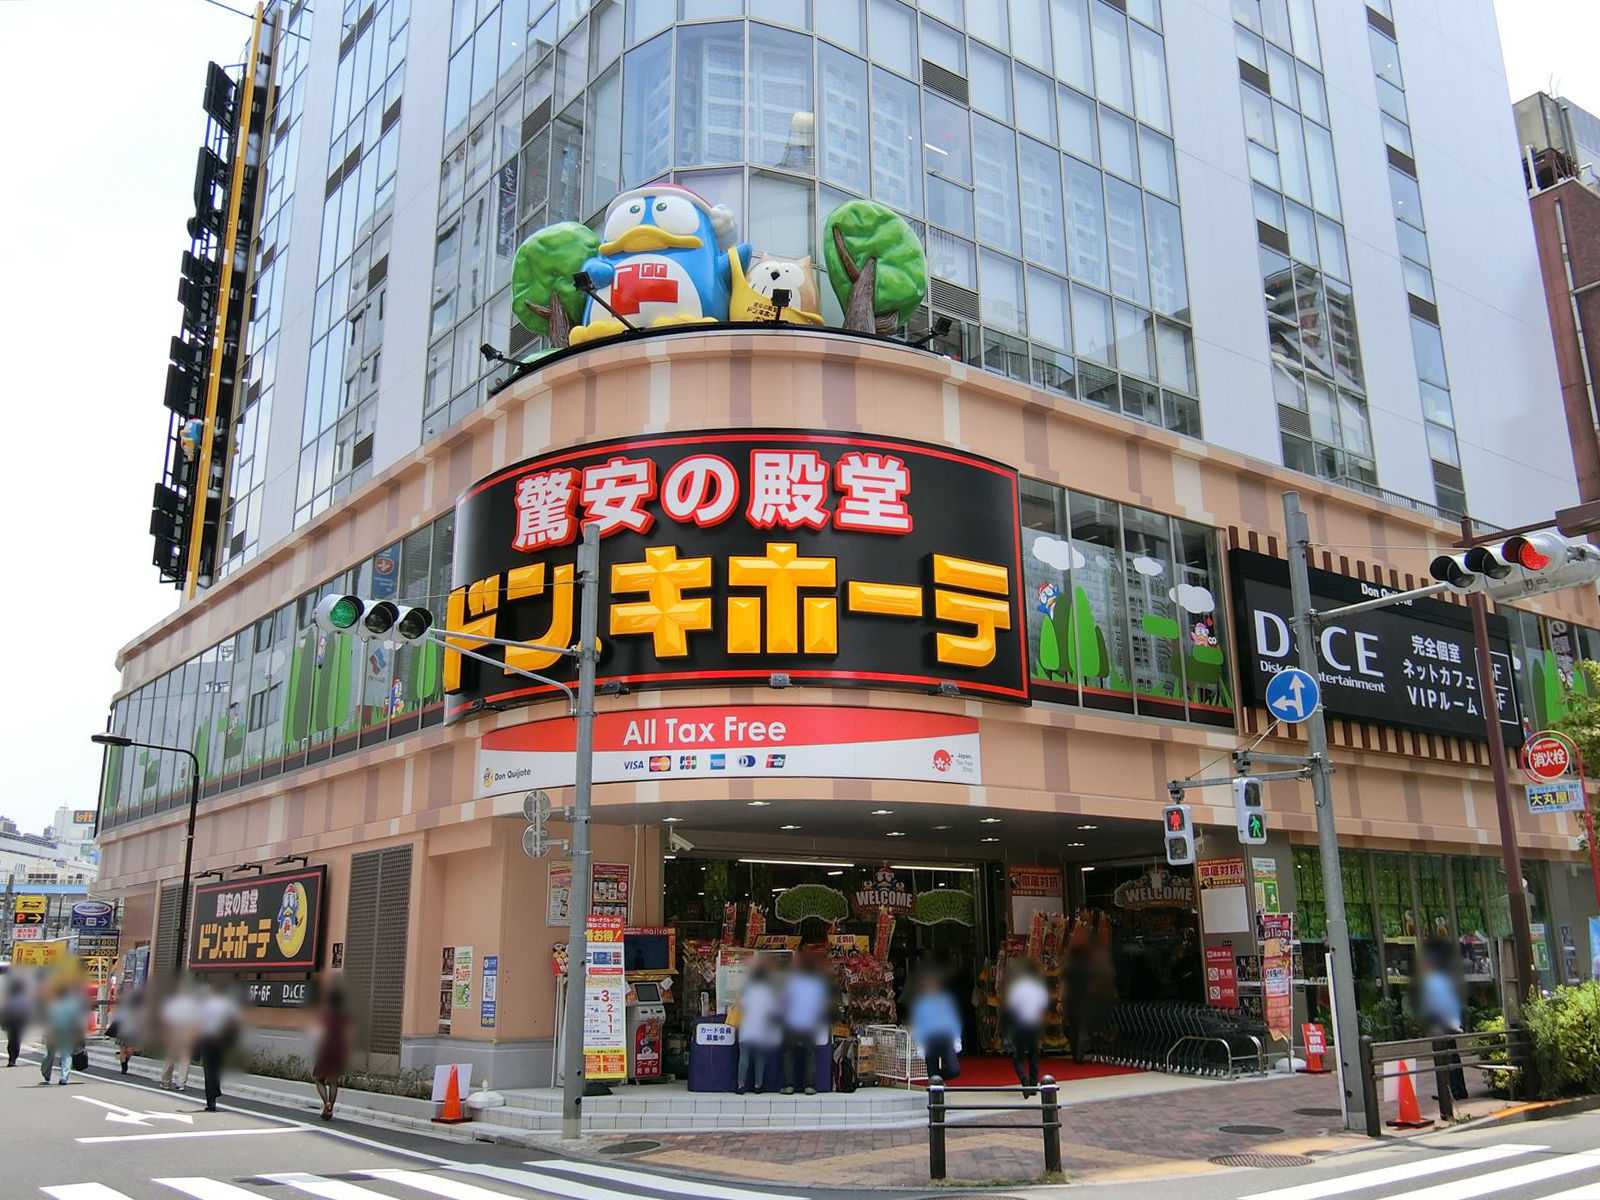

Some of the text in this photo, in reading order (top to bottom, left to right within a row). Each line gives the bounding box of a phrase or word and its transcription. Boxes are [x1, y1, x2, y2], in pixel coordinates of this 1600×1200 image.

[513, 450, 912, 551] 驚安の殿堂
[1360, 583, 1380, 598] Don
[1253, 608, 1384, 678] DCE
[1411, 634, 1462, 664] 完全個室
[1259, 660, 1387, 694] Disk ntertainment
[1402, 658, 1476, 690] ネットカフェ
[1406, 685, 1478, 716] VIPルーム
[622, 716, 787, 746] All Tax Free
[623, 760, 644, 770] VISA
[679, 755, 697, 770] JCB
[1532, 748, 1566, 768] 消火栓
[494, 768, 532, 781] Don Quijote
[1531, 791, 1569, 806] 大丸屋
[855, 890, 913, 908] WELCOME
[1125, 886, 1193, 903] WELCOME
[16, 913, 25, 923] P
[601, 989, 610, 1002] 3
[607, 1004, 614, 1013] 2
[700, 1026, 732, 1034] カード会員
